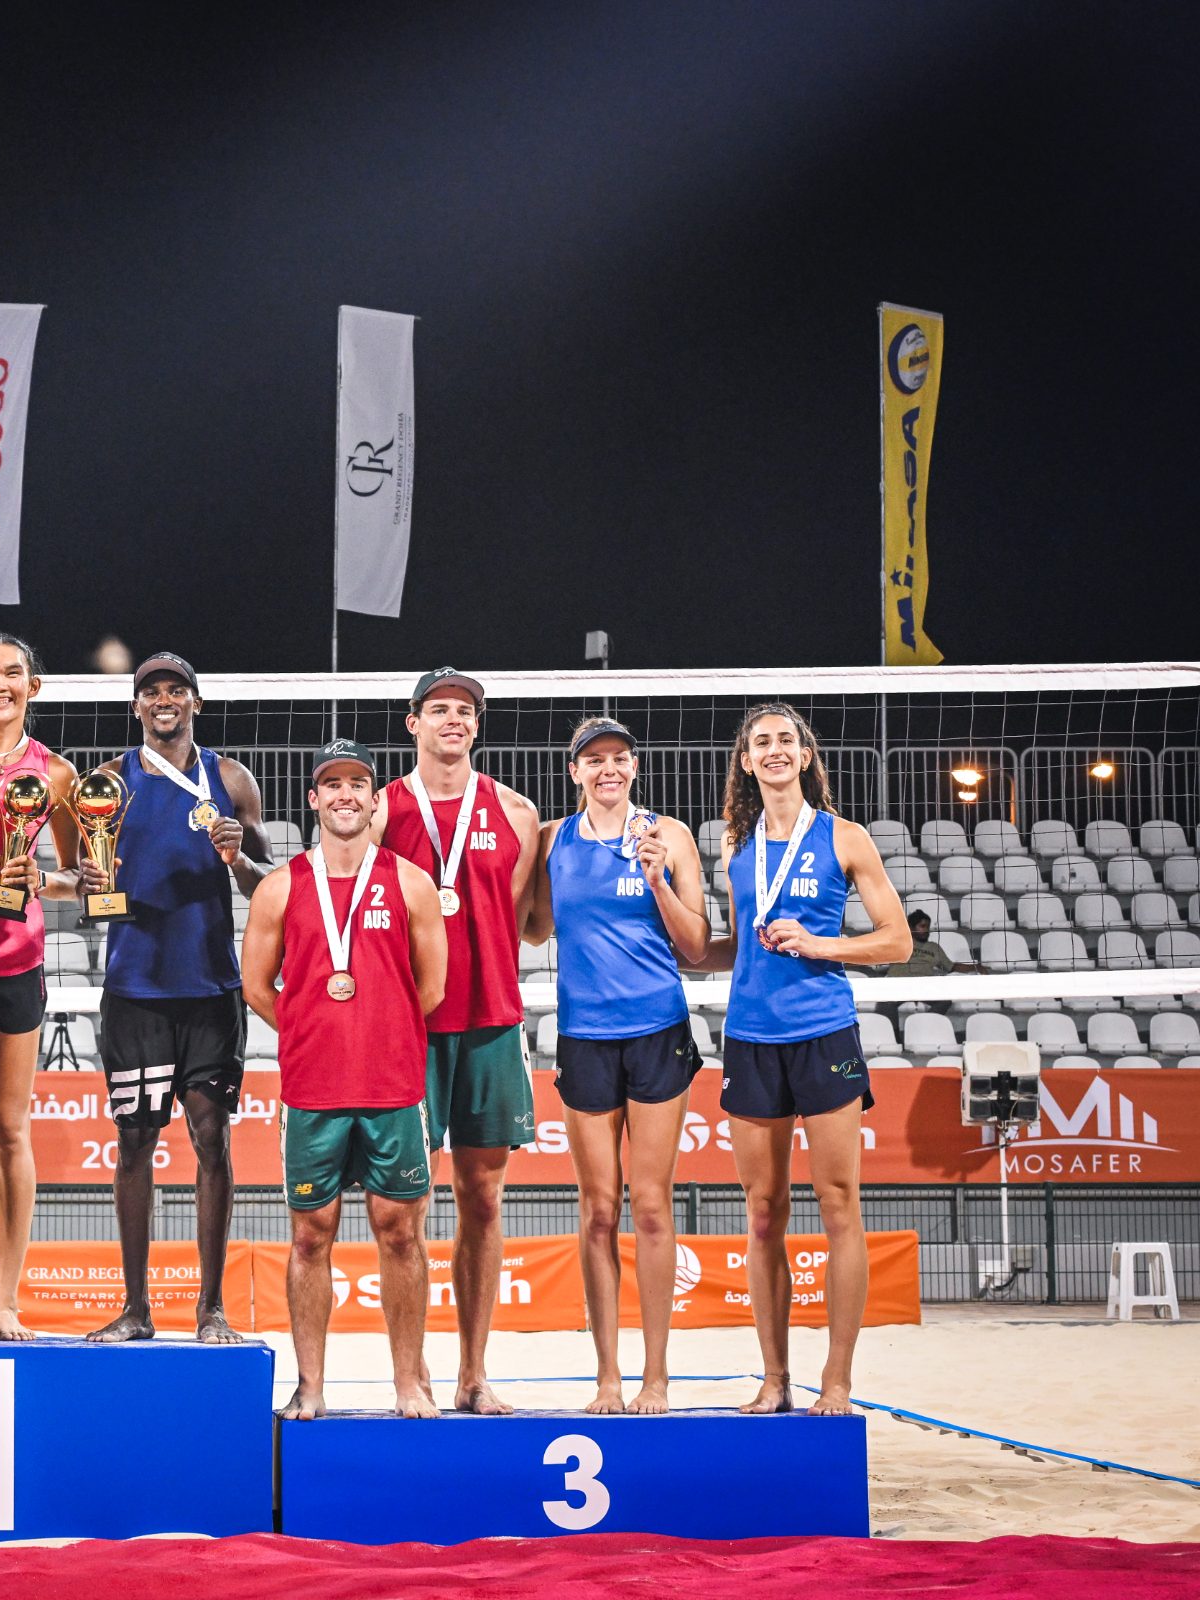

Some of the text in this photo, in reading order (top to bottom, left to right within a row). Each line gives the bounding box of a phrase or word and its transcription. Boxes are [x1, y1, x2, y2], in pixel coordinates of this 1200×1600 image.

[476, 808, 487, 829] 1
[470, 831, 497, 851] AUS
[800, 852, 815, 873] 2
[370, 884, 384, 907] 2
[616, 877, 644, 897] AUS
[789, 877, 819, 898] AUS
[363, 909, 391, 929] AUS
[81, 1141, 171, 1169] 206
[1002, 1154, 1143, 1174] MOSAFER
[27, 1267, 84, 1280] GRAND
[164, 1266, 201, 1280] DOH
[33, 1291, 116, 1300] TRADEMARK
[357, 1270, 532, 1308] Snh
[74, 1301, 92, 1309] BY
[542, 1433, 611, 1531] 3
